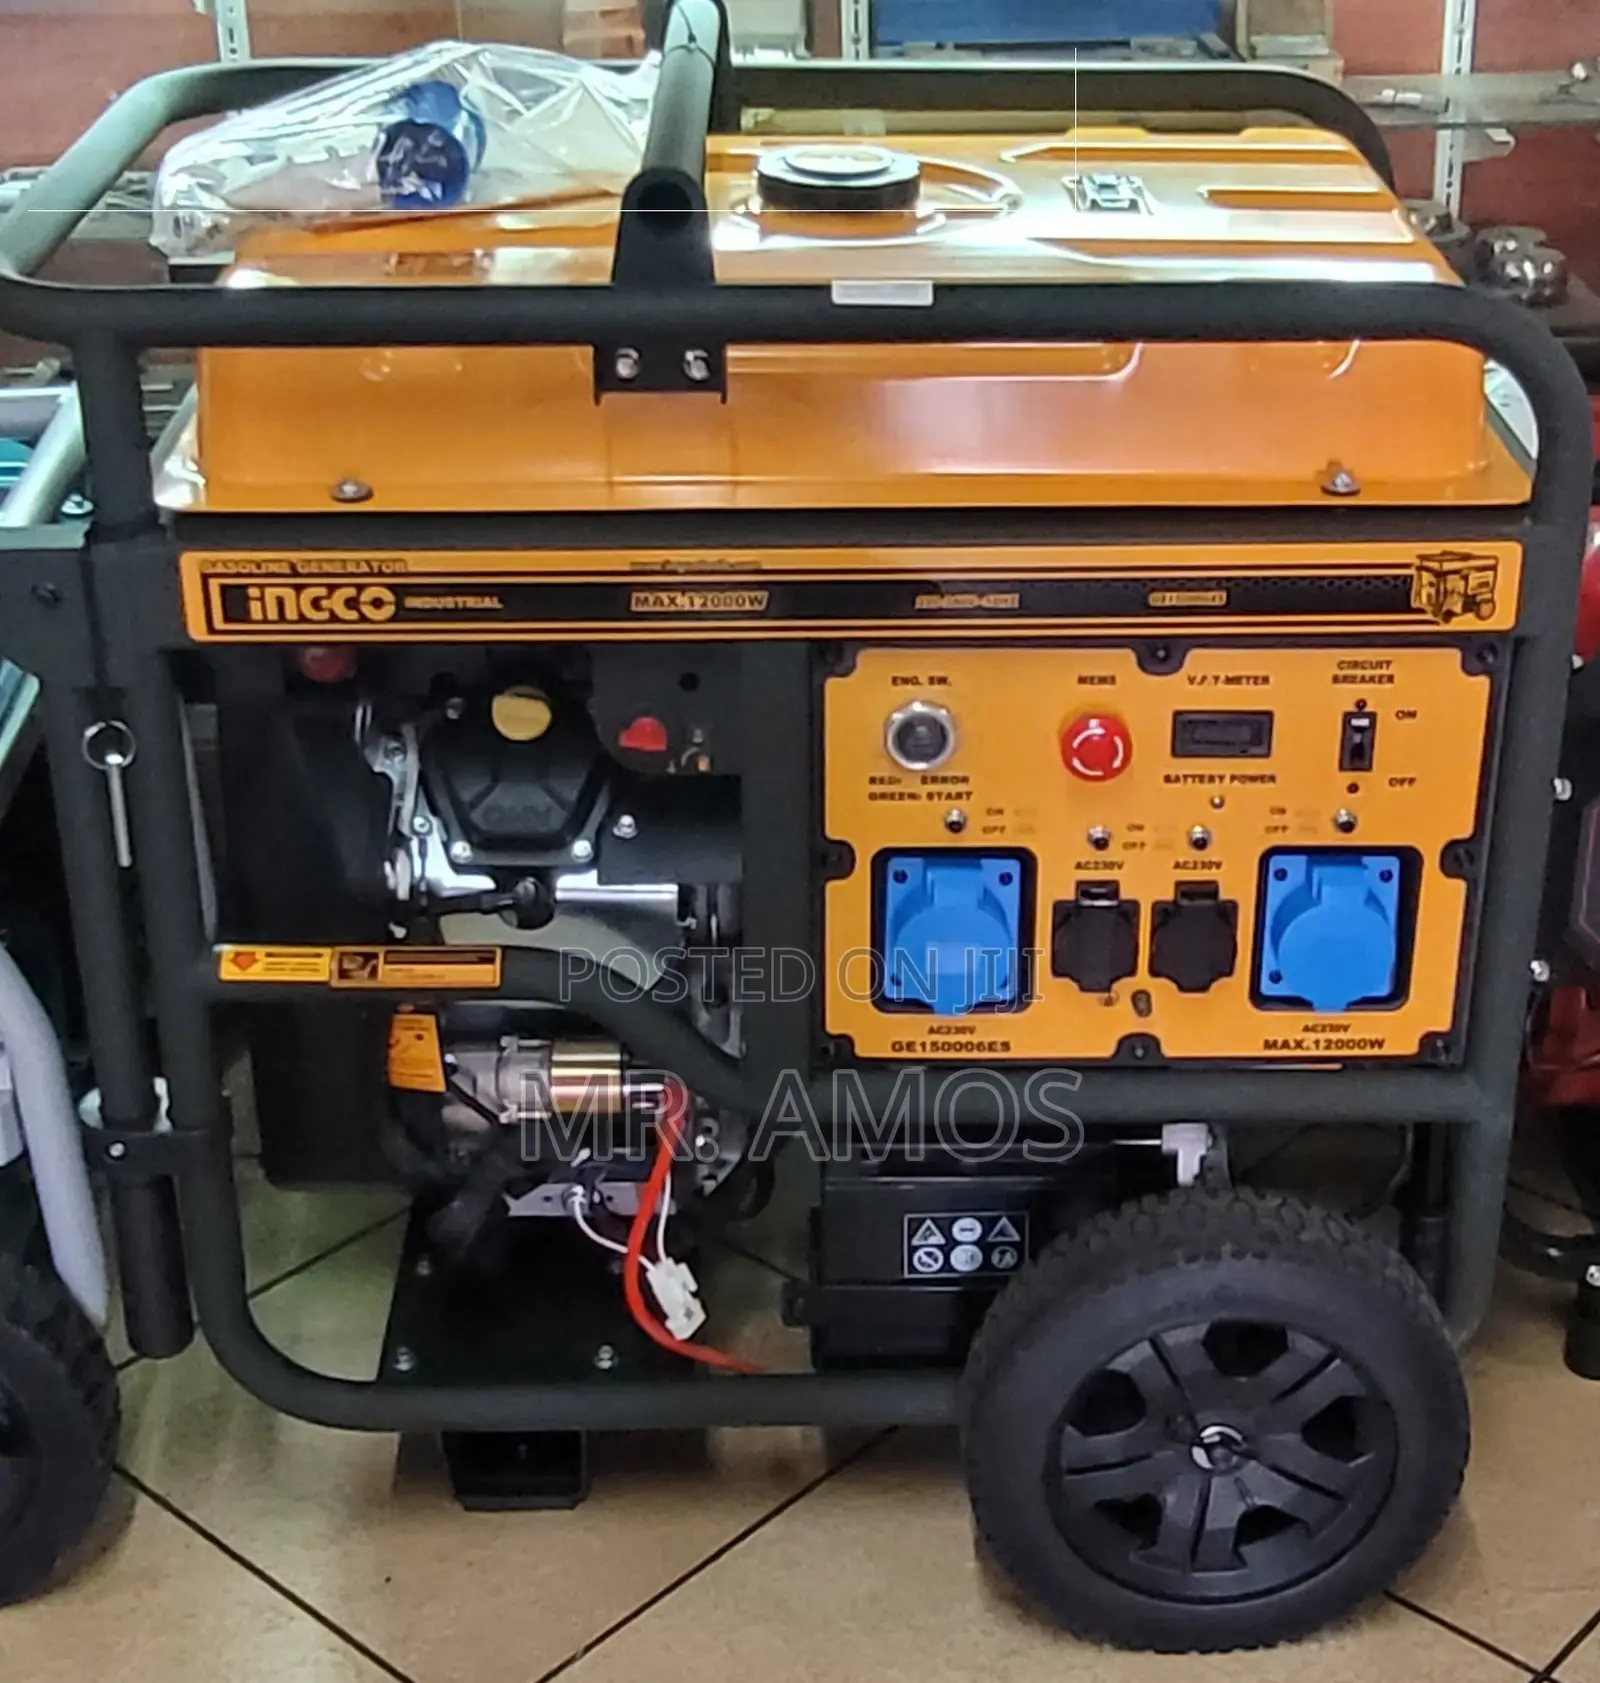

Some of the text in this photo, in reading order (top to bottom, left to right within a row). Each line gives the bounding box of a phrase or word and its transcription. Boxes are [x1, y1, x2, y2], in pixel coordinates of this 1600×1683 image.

[201, 559, 407, 574] GASOLINE GENERATOR
[1337, 660, 1393, 671] CIRCUIT
[891, 675, 923, 687] ENG.
[1331, 674, 1395, 685] BREAKER
[1395, 709, 1417, 720] ON
[920, 775, 970, 785] ERROR
[1163, 773, 1277, 784] BATTERY POWER
[1388, 777, 1416, 788] OFF
[925, 791, 973, 801] START
[1074, 860, 1124, 871] AC230V
[1172, 860, 1223, 871] AC230V
[1263, 1037, 1386, 1051] MAX.12000W
